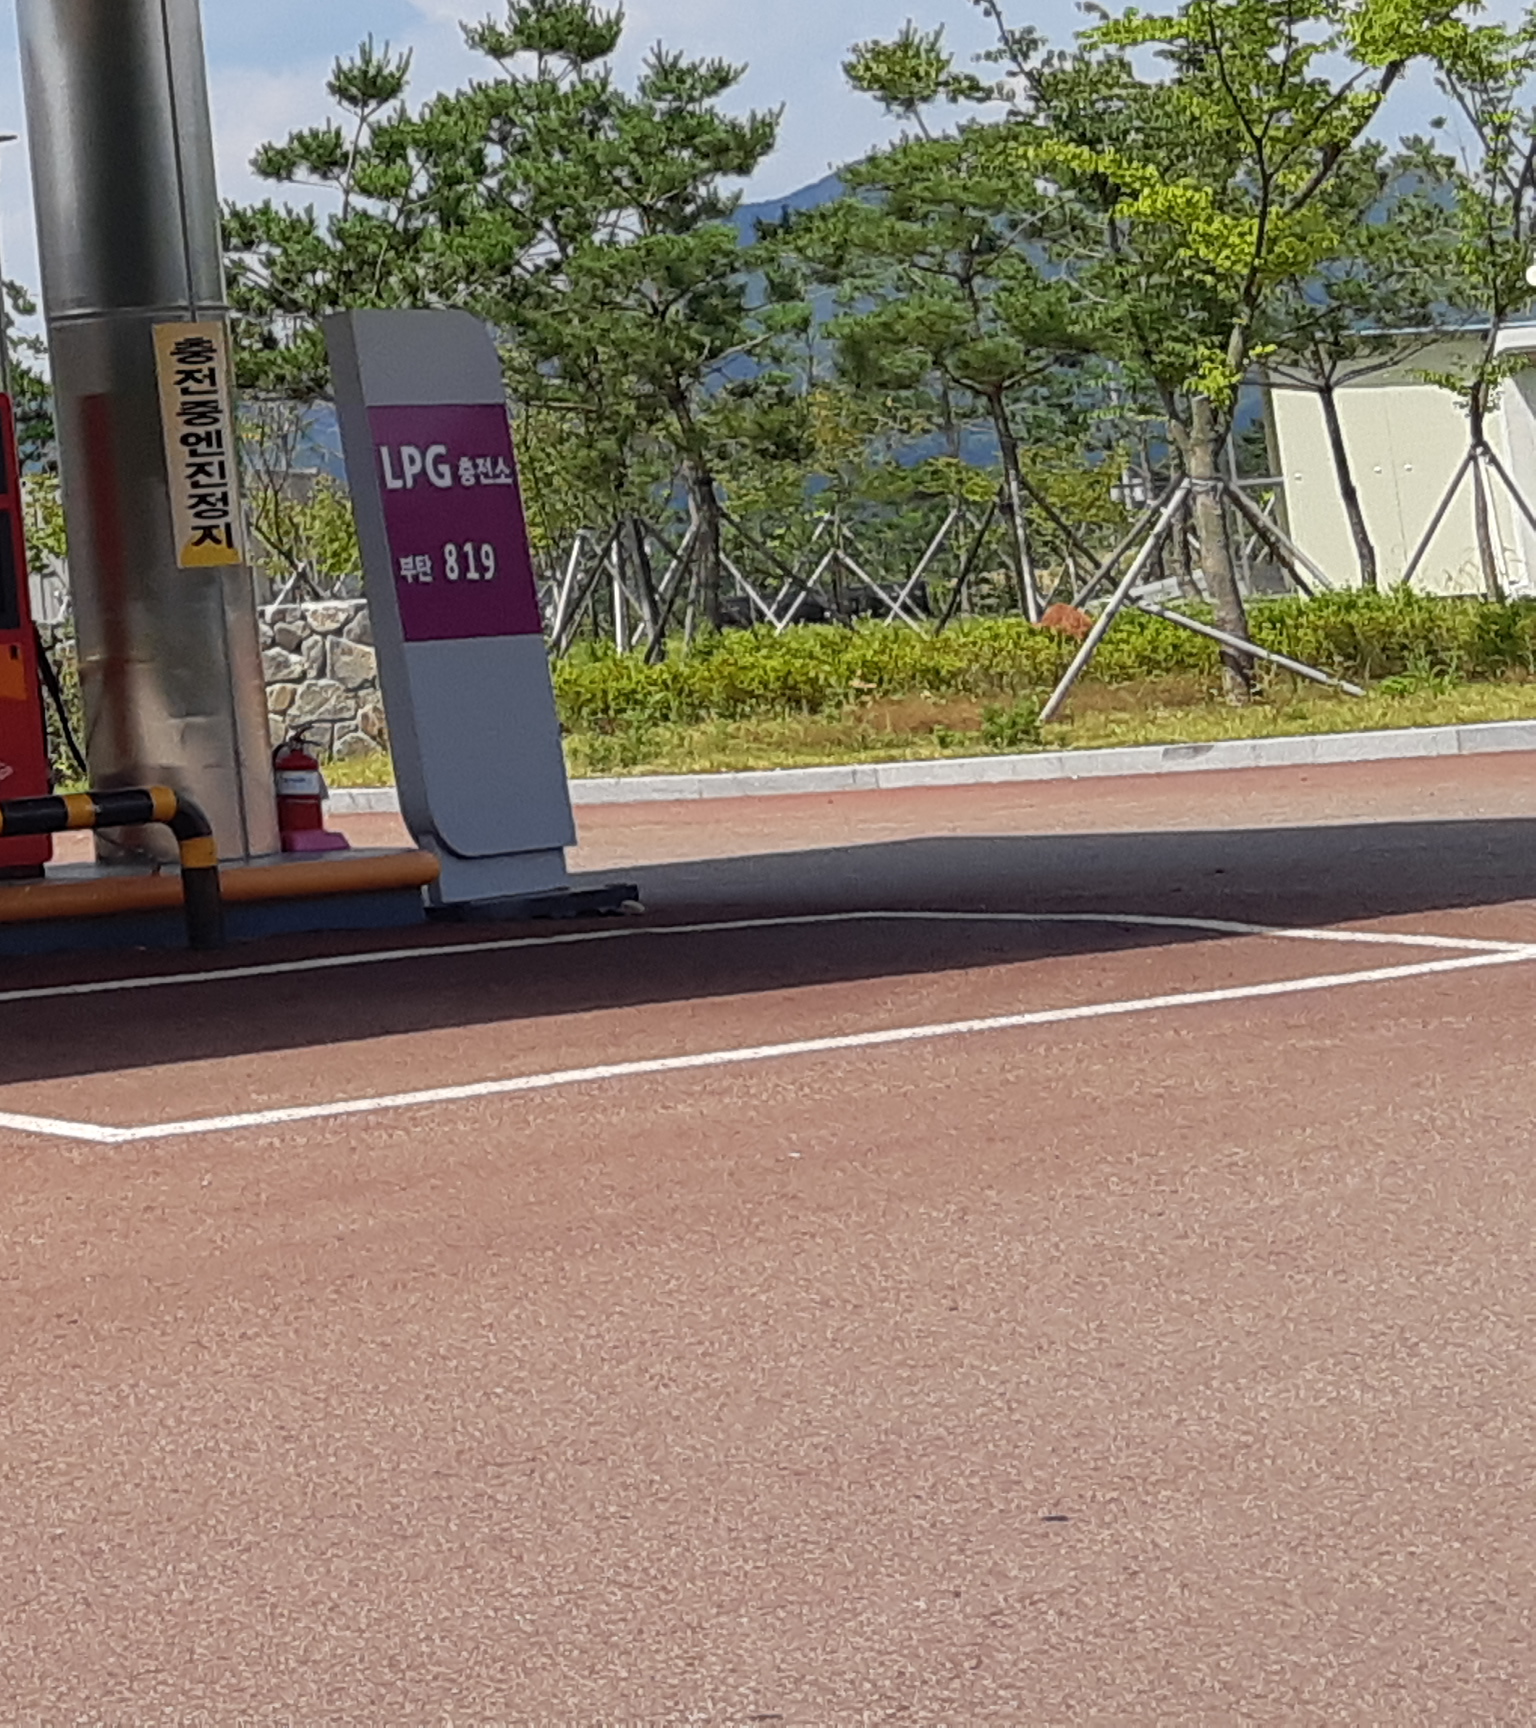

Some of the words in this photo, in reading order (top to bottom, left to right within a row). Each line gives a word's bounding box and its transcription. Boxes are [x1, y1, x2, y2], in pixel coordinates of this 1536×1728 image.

[170, 336, 234, 549] 충전중엔진정지
[380, 445, 452, 489] LPG
[458, 456, 513, 487] 충전소
[399, 555, 433, 583] 부탄
[444, 542, 495, 580] 819
